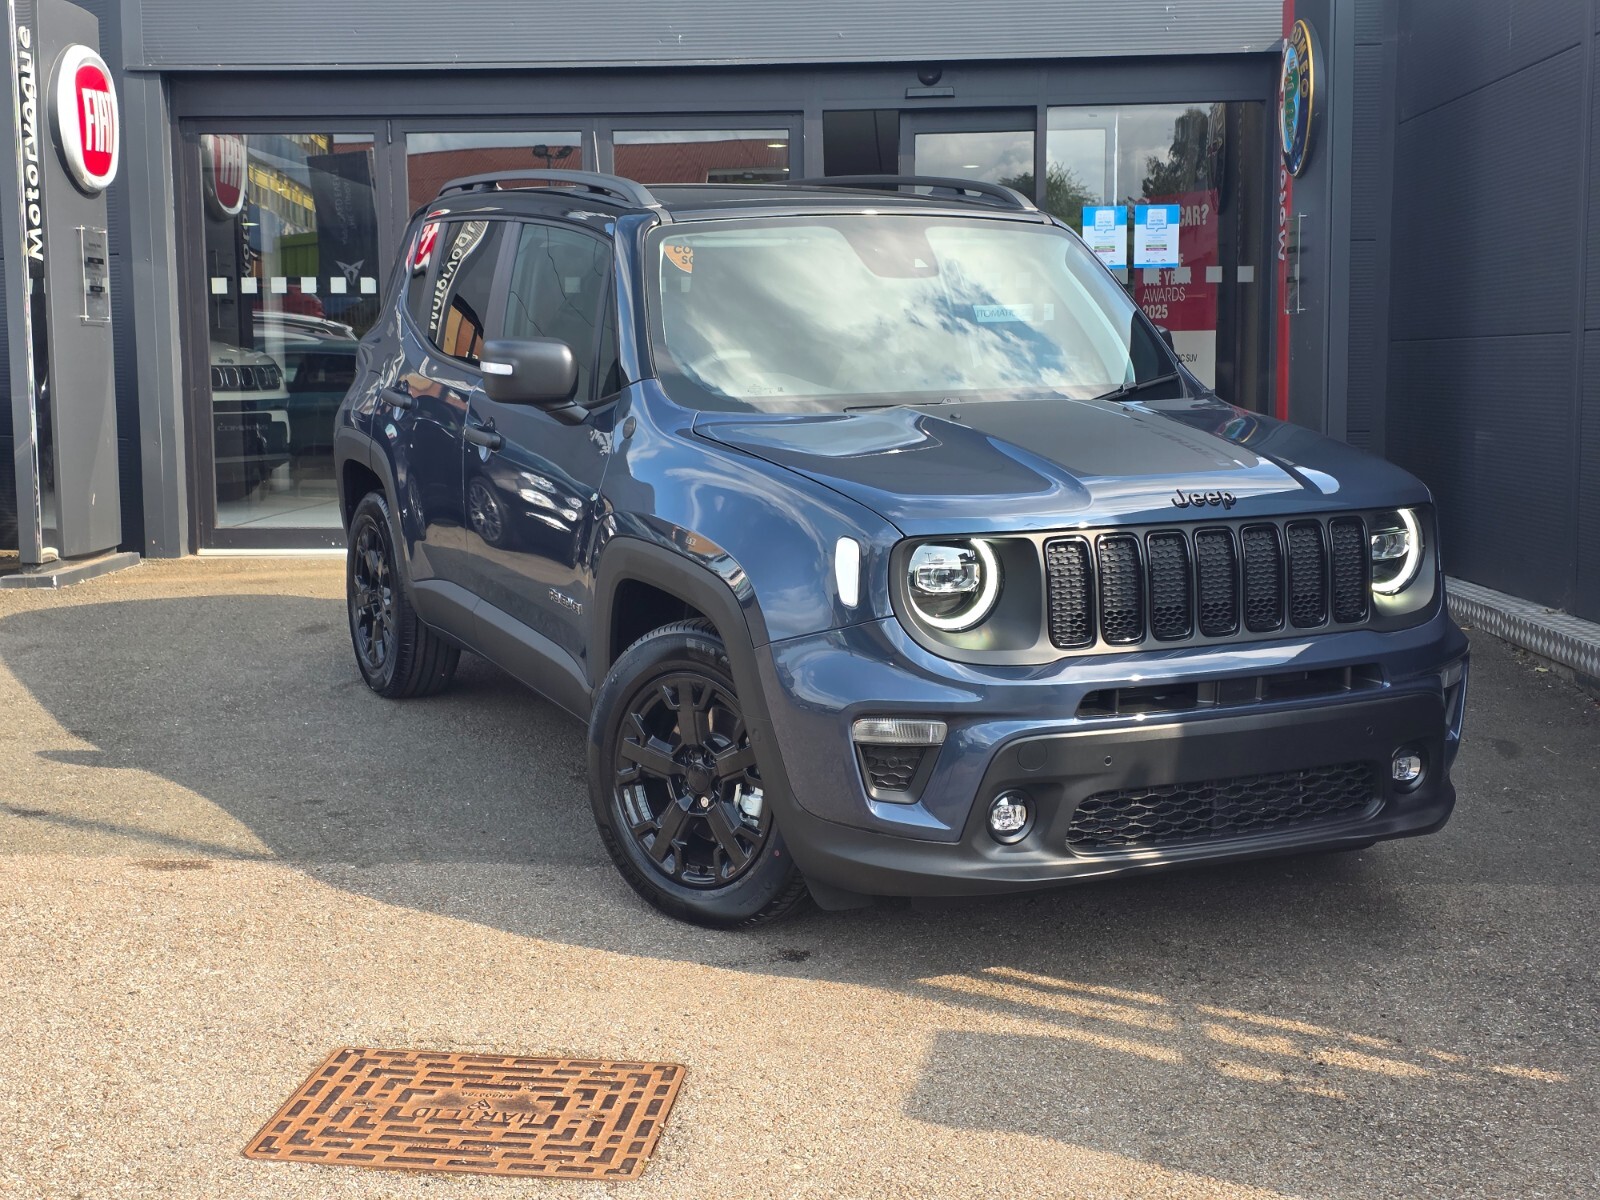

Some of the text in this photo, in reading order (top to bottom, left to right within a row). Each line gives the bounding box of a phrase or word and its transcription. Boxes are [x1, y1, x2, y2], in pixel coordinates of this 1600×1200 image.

[81, 87, 113, 154] FIAT
[1143, 287, 1186, 303] AWARDS
[1143, 304, 1168, 319] 2025
[1171, 489, 1237, 510] Jeep
